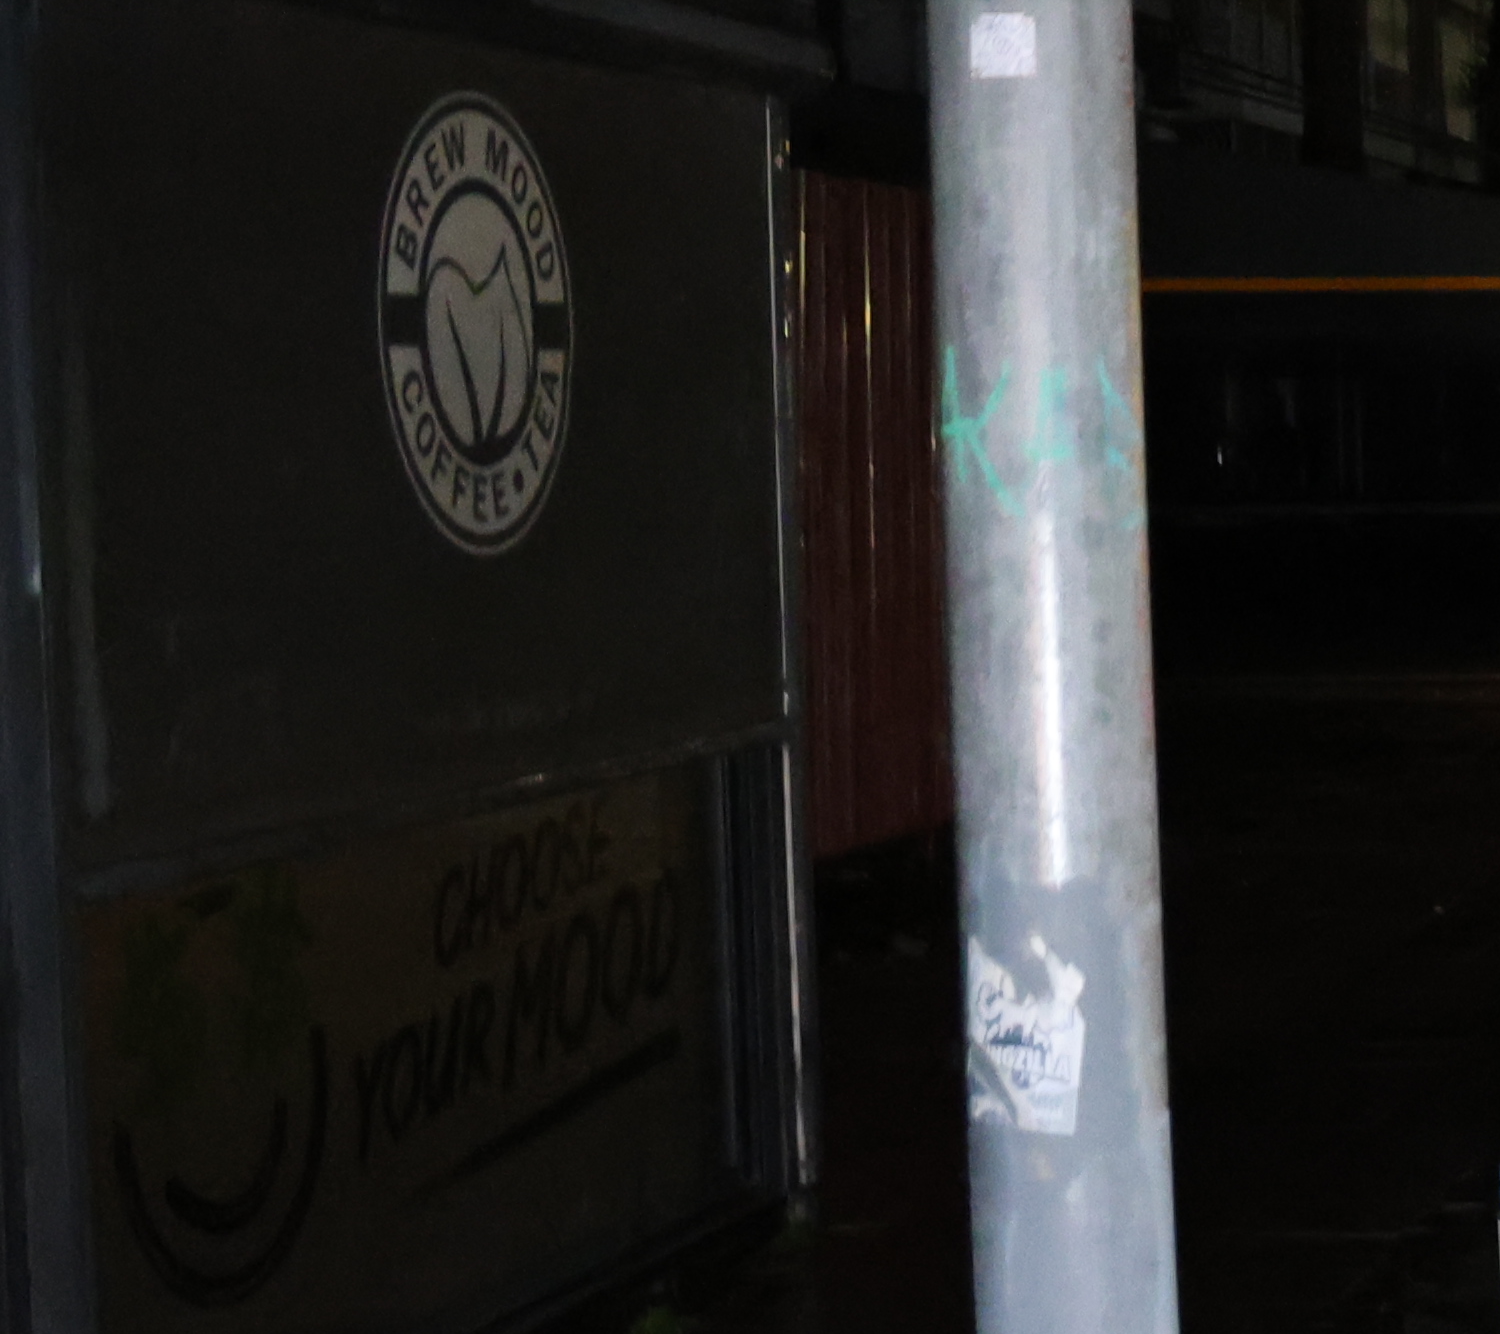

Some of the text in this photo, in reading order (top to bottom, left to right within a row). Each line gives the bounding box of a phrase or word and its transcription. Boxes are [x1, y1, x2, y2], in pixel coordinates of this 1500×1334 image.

[396, 123, 555, 280] BREW MOOD
[403, 371, 560, 523] COFFEE TEA
[433, 799, 612, 967] CHOOSE
[355, 867, 679, 1162] YOUR MOOD
